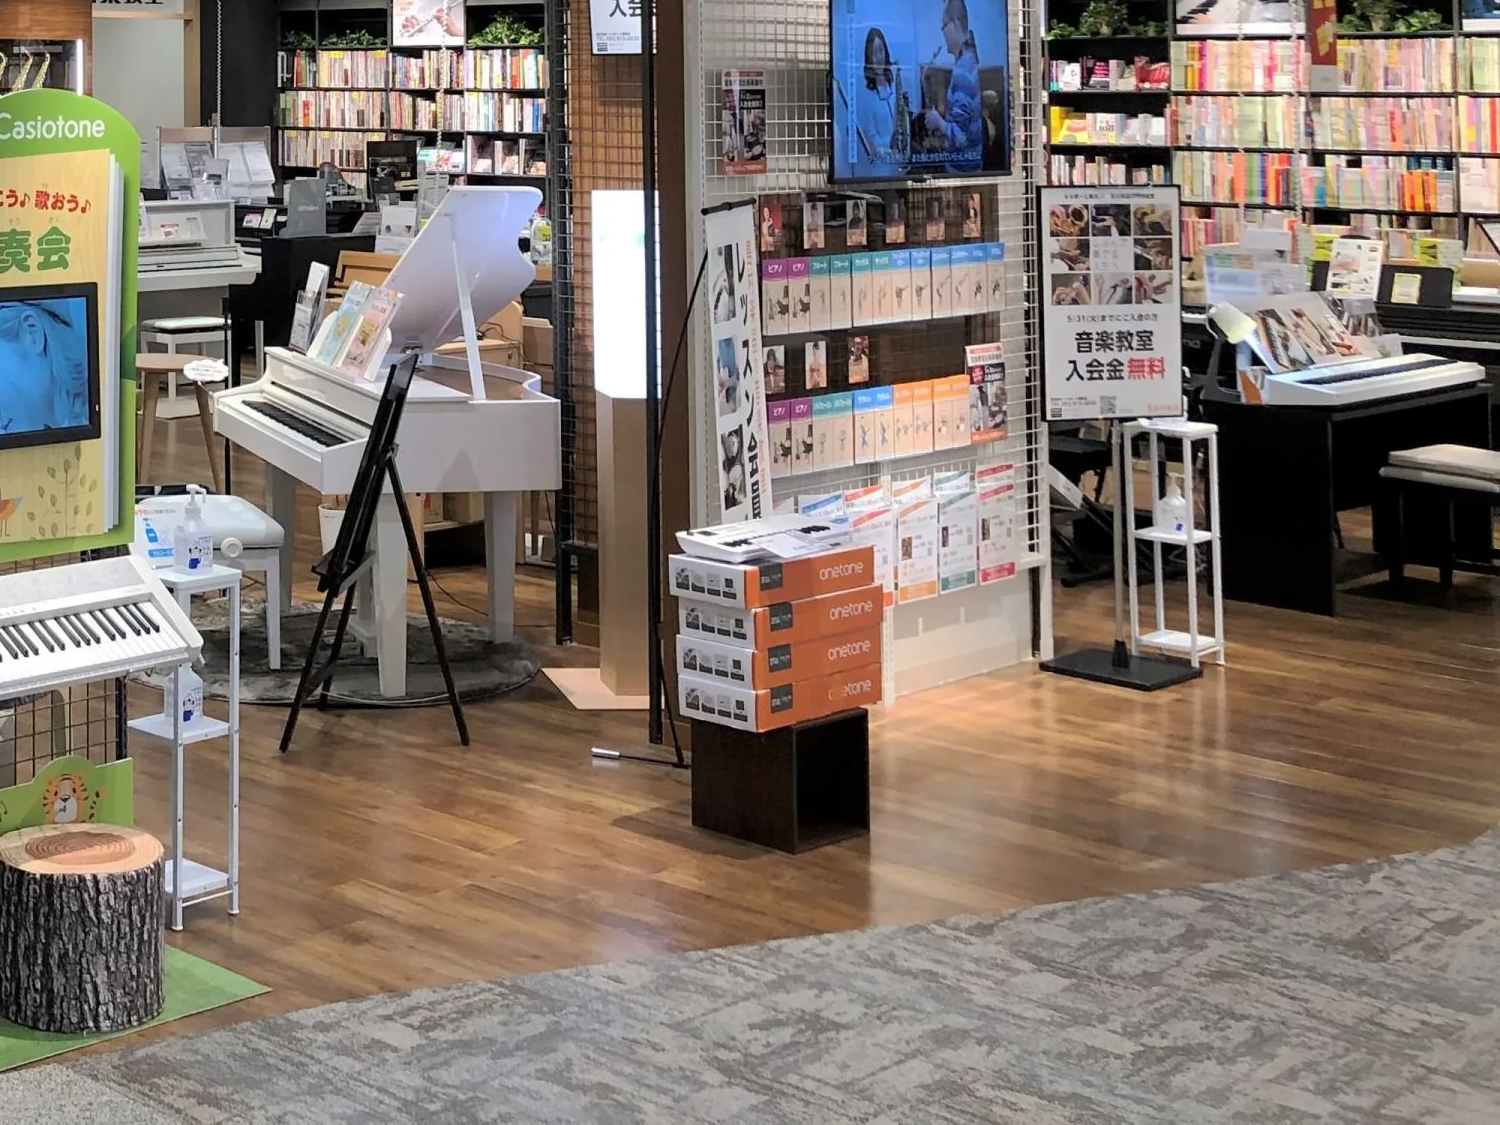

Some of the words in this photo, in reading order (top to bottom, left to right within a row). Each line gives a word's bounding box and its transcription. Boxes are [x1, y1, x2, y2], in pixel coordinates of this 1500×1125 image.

[767, 264, 783, 274] ピアノ
[792, 263, 806, 272] ピアノ
[1075, 329, 1155, 353] 音楽教室
[773, 407, 786, 416] ピアノ
[795, 405, 808, 414] ピアノ
[819, 561, 864, 581] onetone
[829, 600, 874, 620] onetone
[827, 640, 871, 660] onetone
